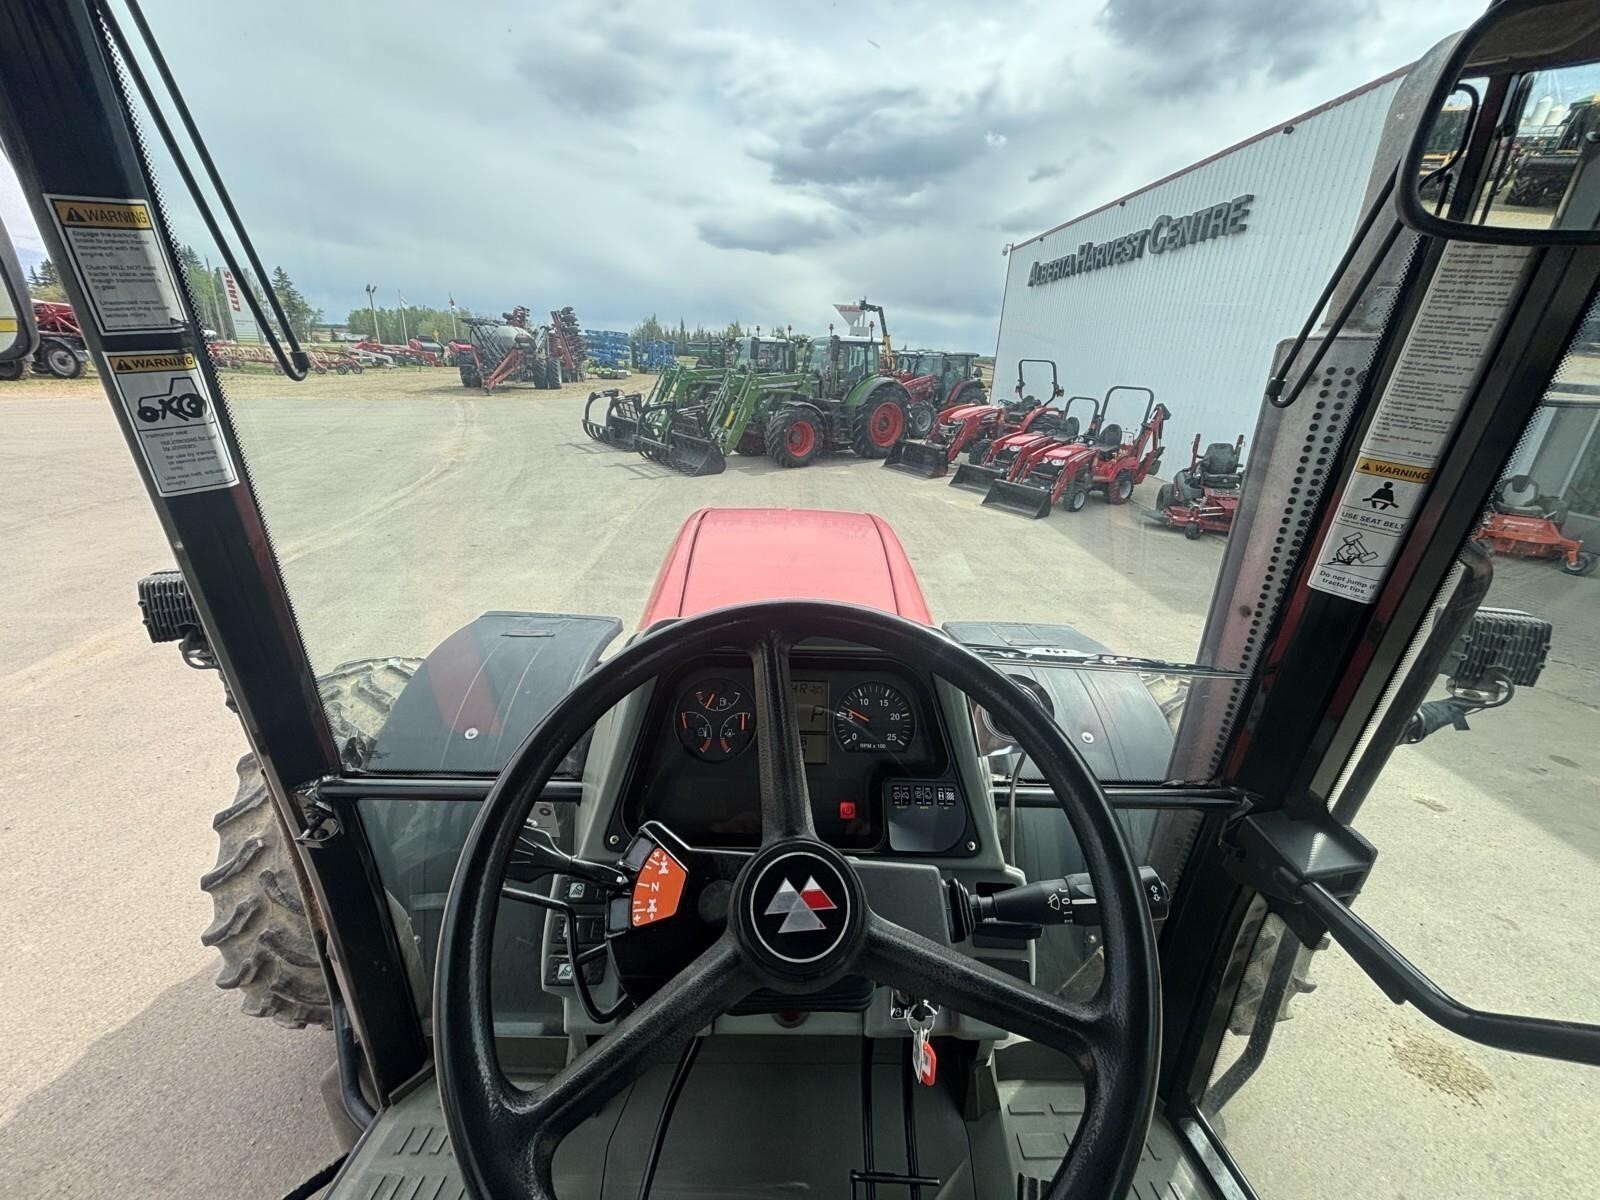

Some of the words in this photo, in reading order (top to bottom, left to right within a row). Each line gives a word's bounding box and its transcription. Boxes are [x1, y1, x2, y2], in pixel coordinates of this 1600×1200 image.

[84, 207, 147, 224] WARNING
[1028, 254, 1076, 287] ALBERTA
[1076, 229, 1150, 274] HARVEST
[1148, 194, 1255, 254] CENTRE
[132, 356, 193, 369] WARNING
[1375, 464, 1430, 480] WARNING
[1342, 511, 1358, 521] USE
[1360, 515, 1382, 526] SEAT
[1320, 570, 1331, 578] Do
[1332, 573, 1346, 581] not
[1347, 577, 1368, 589] jump
[1322, 578, 1348, 589] tractor
[860, 698, 869, 706] 10
[880, 699, 889, 707] 15
[811, 705, 825, 723] P
[890, 713, 900, 721] 20
[887, 733, 897, 741] 25
[651, 882, 660, 891] N
